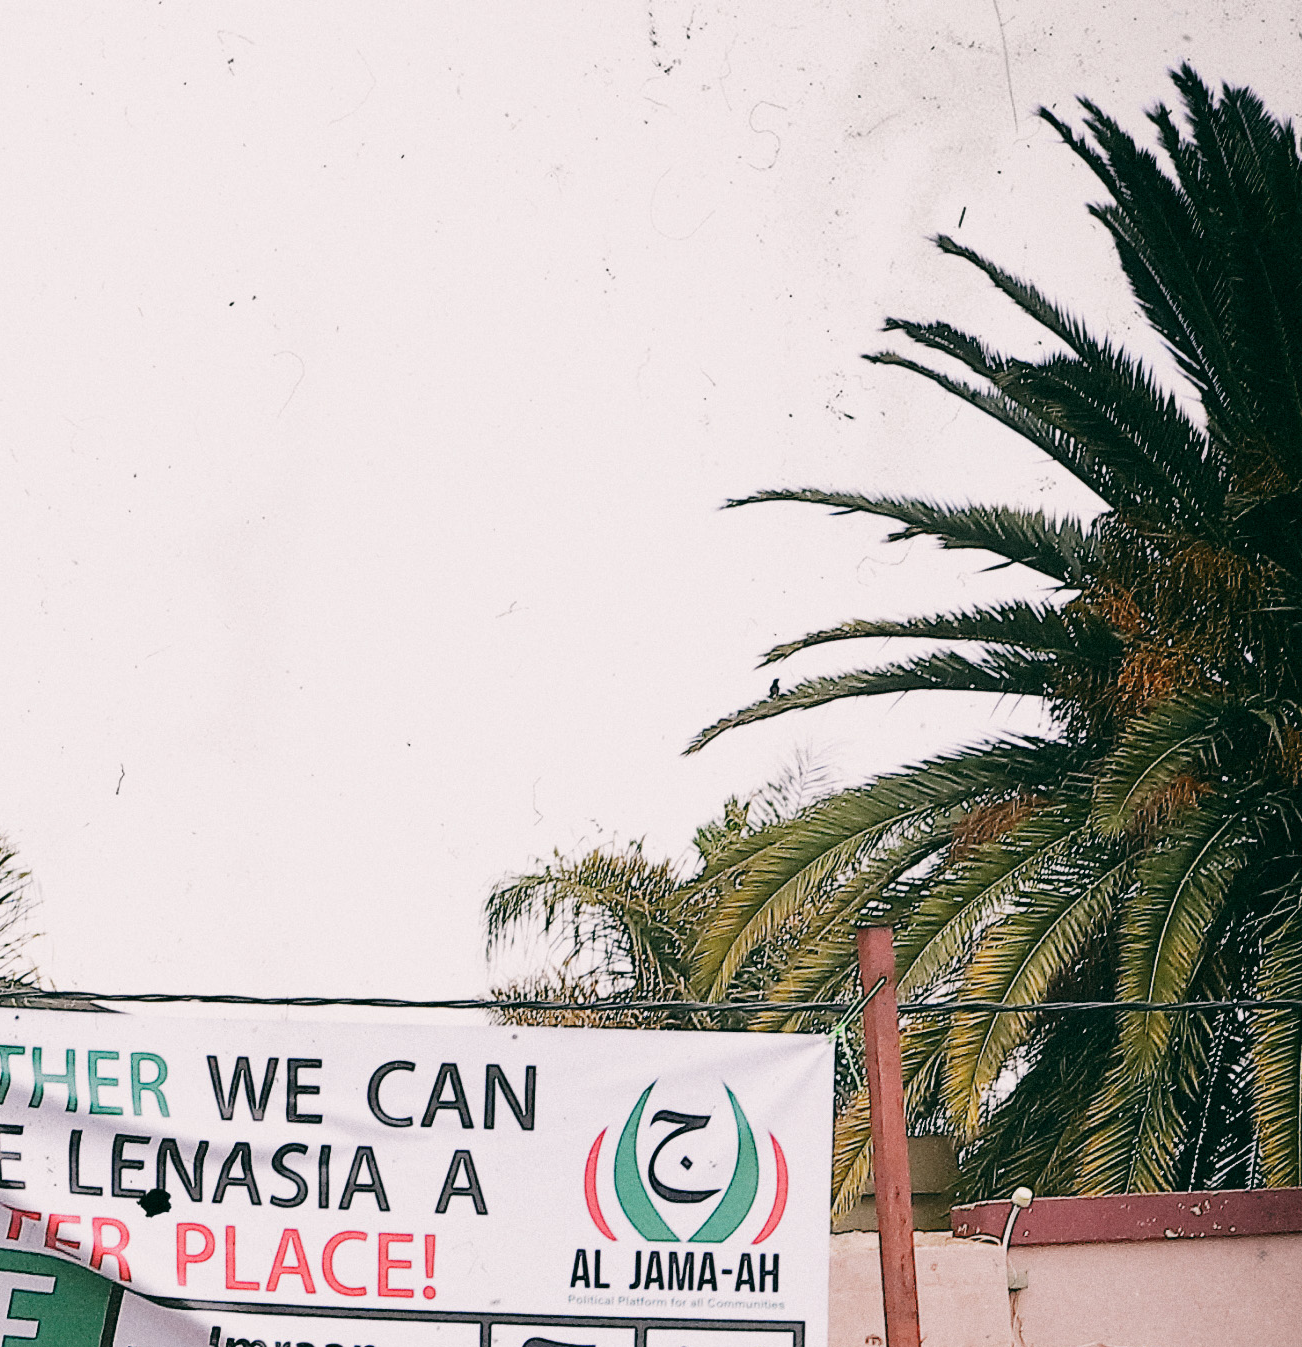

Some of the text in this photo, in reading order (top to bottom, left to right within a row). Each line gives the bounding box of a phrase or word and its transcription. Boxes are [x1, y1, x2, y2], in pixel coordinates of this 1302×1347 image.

[207, 1055, 323, 1124] WE
[367, 1061, 536, 1131] CAN
[69, 1128, 390, 1212] LENASIA
[435, 1150, 488, 1216] A
[175, 1222, 437, 1301] PLACE!
[570, 1249, 780, 1292] AL JAMA-AH
[568, 1294, 785, 1310] Political Platform for all Communities
